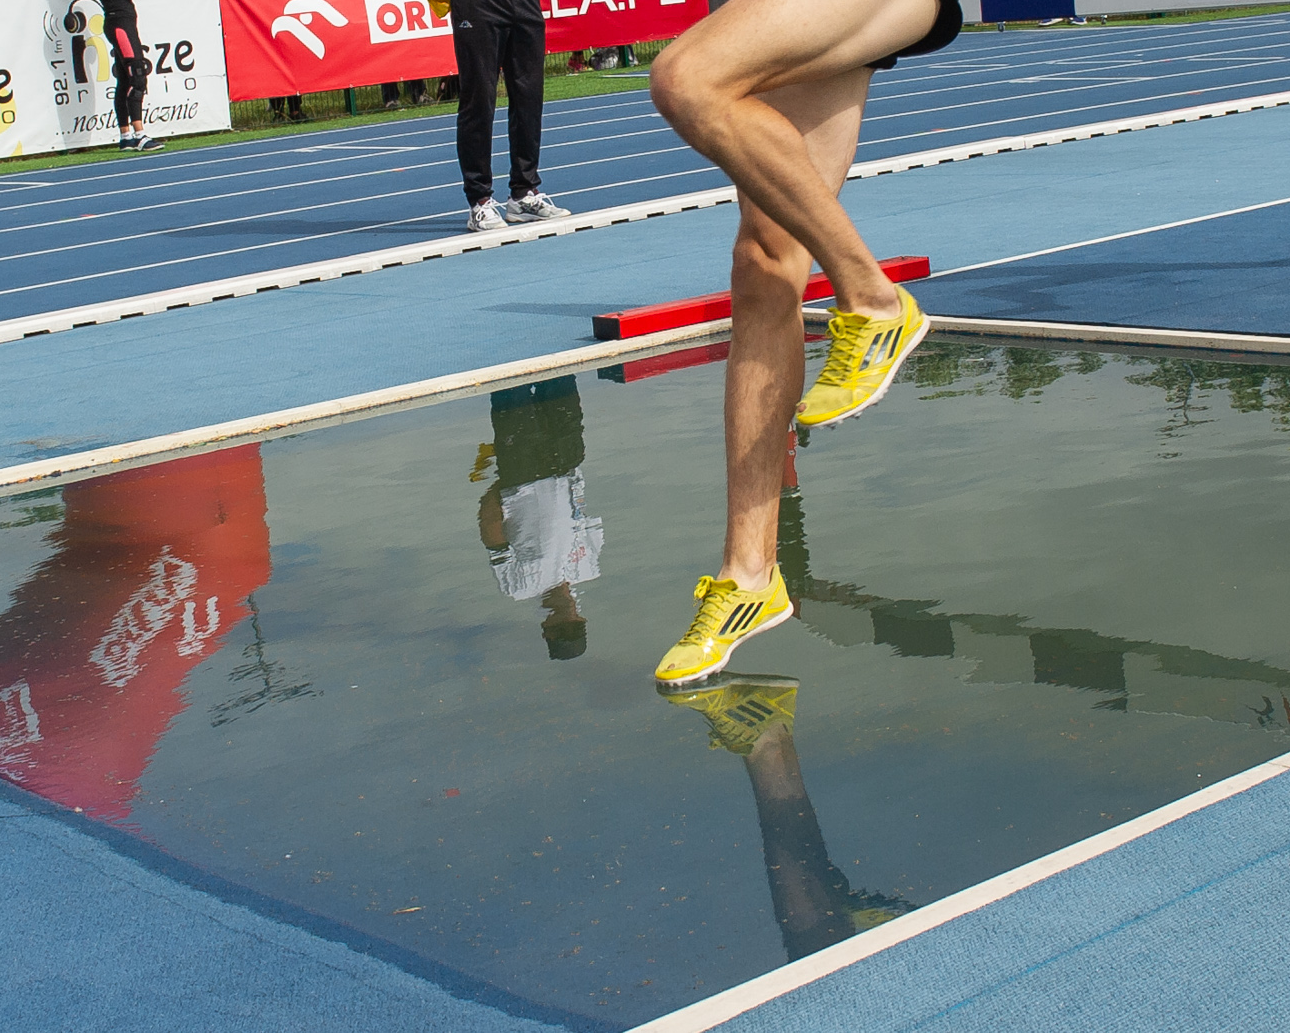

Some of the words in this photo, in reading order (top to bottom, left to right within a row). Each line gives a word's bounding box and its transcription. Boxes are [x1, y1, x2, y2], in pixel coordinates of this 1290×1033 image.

[376, 0, 449, 34] ORL
[54, 39, 63, 54] fm
[71, 35, 195, 84] nze
[50, 59, 70, 106] 92.1
[77, 76, 197, 104] raio
